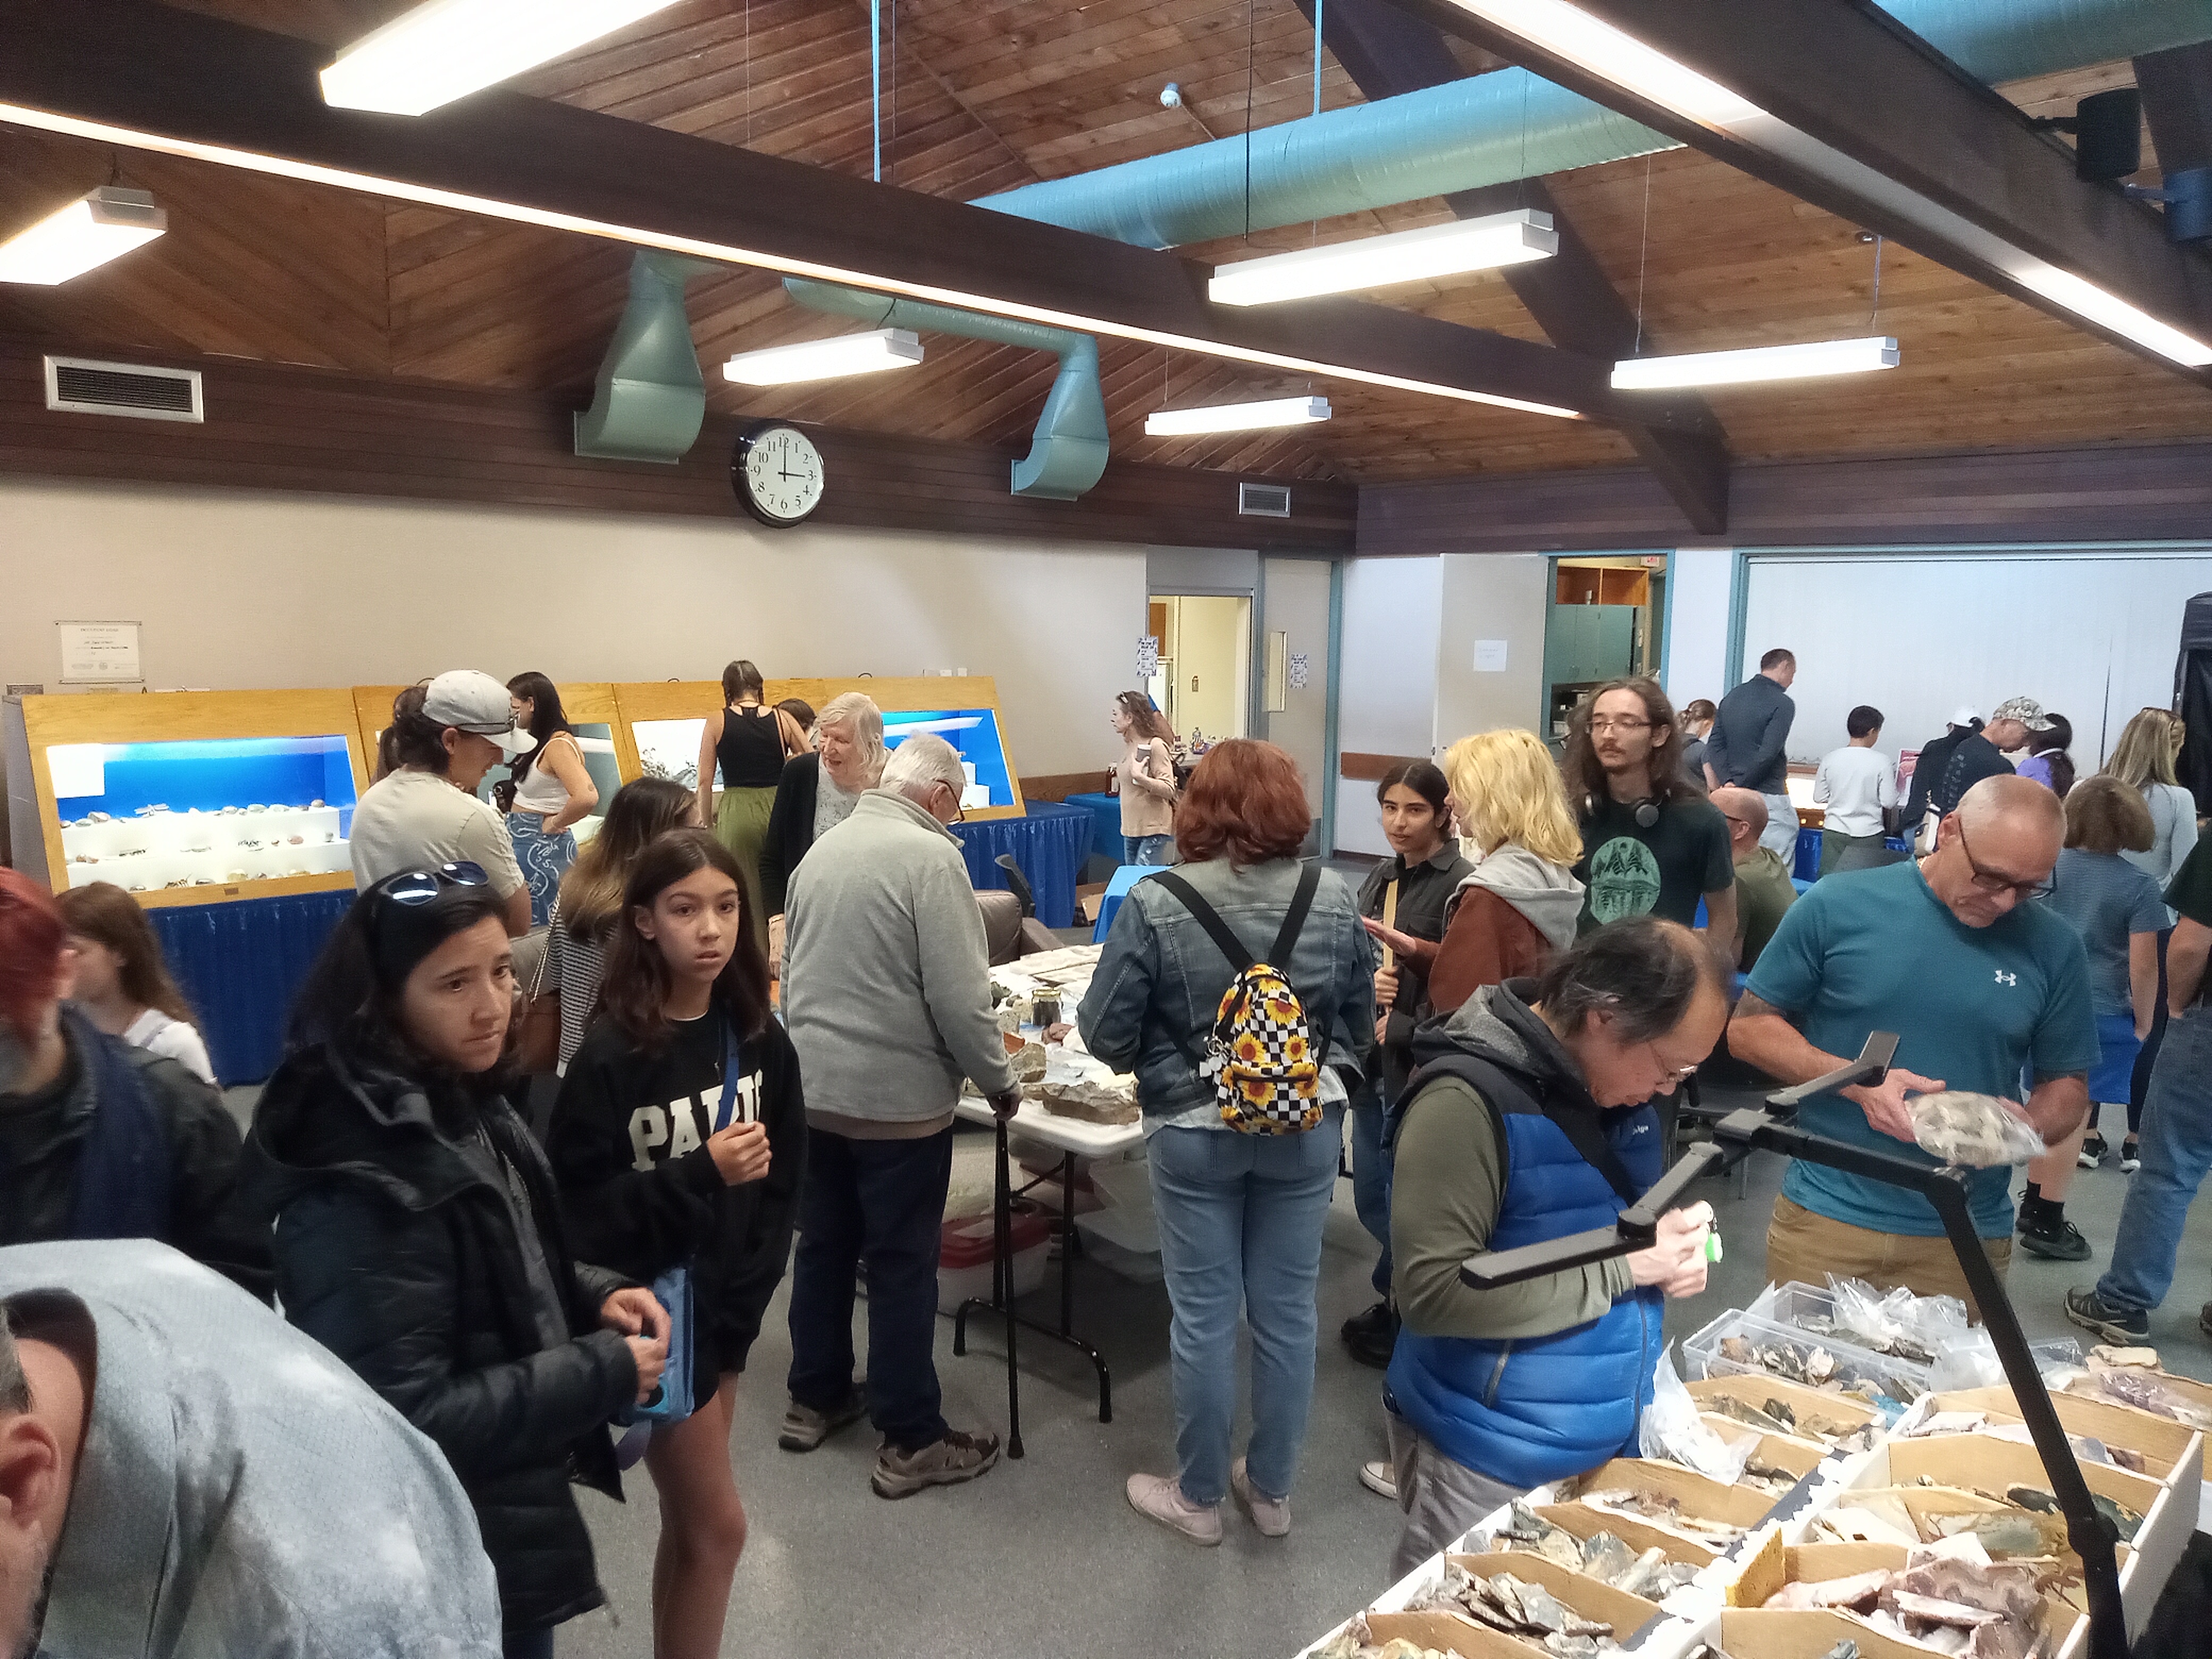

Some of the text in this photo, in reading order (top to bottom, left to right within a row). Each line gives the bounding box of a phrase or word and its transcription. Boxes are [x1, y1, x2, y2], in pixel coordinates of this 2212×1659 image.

[768, 440, 776, 452] 11
[779, 437, 789, 448] 12
[758, 453, 769, 463] 10
[802, 454, 809, 464] 2
[753, 466, 761, 476] 9
[807, 470, 814, 481] 3
[758, 481, 765, 492] 8
[803, 484, 809, 495] 4
[769, 494, 776, 505] 7
[780, 498, 787, 509] 6
[795, 495, 802, 506] 5
